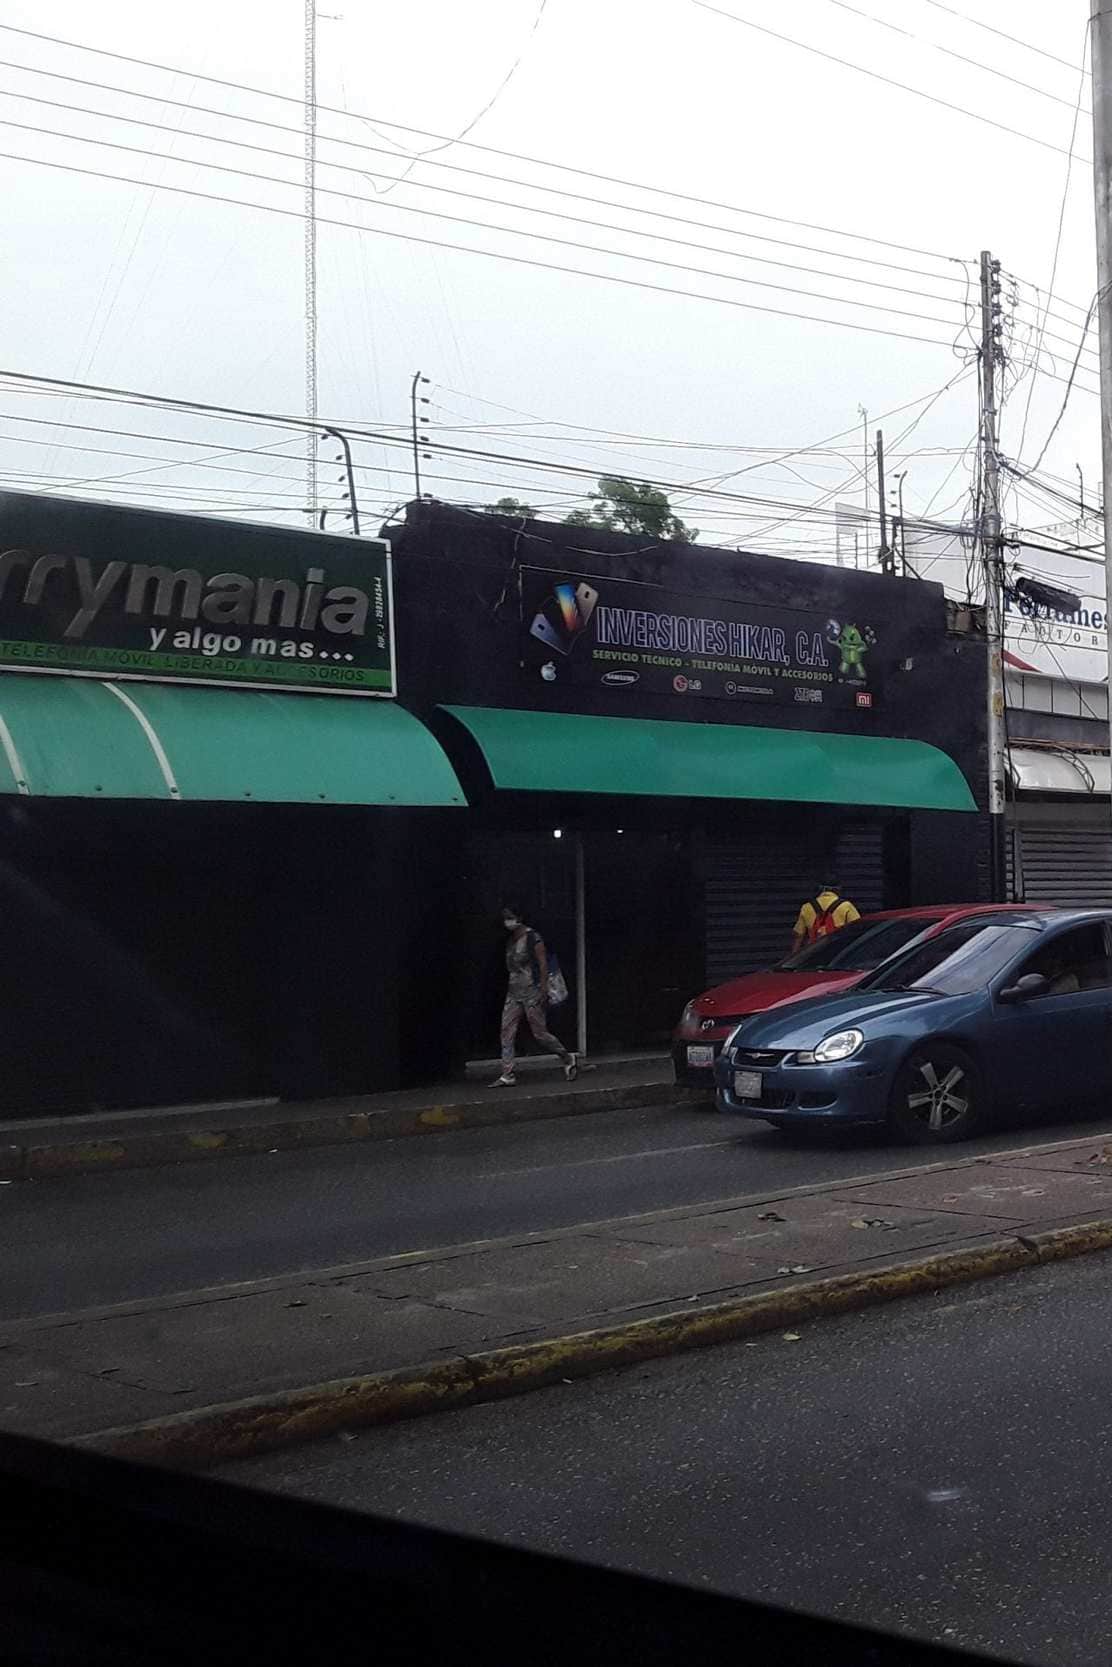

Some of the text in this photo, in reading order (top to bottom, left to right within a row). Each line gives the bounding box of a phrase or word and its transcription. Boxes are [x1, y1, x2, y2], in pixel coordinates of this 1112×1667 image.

[150, 627, 354, 661] y algo mas...
[597, 606, 727, 655] INVERSIONES
[796, 632, 829, 667] C.A.
[593, 650, 639, 663] SERVICIO
[642, 654, 682, 668] TECNICO
[782, 669, 834, 683] ACCESORIOS
